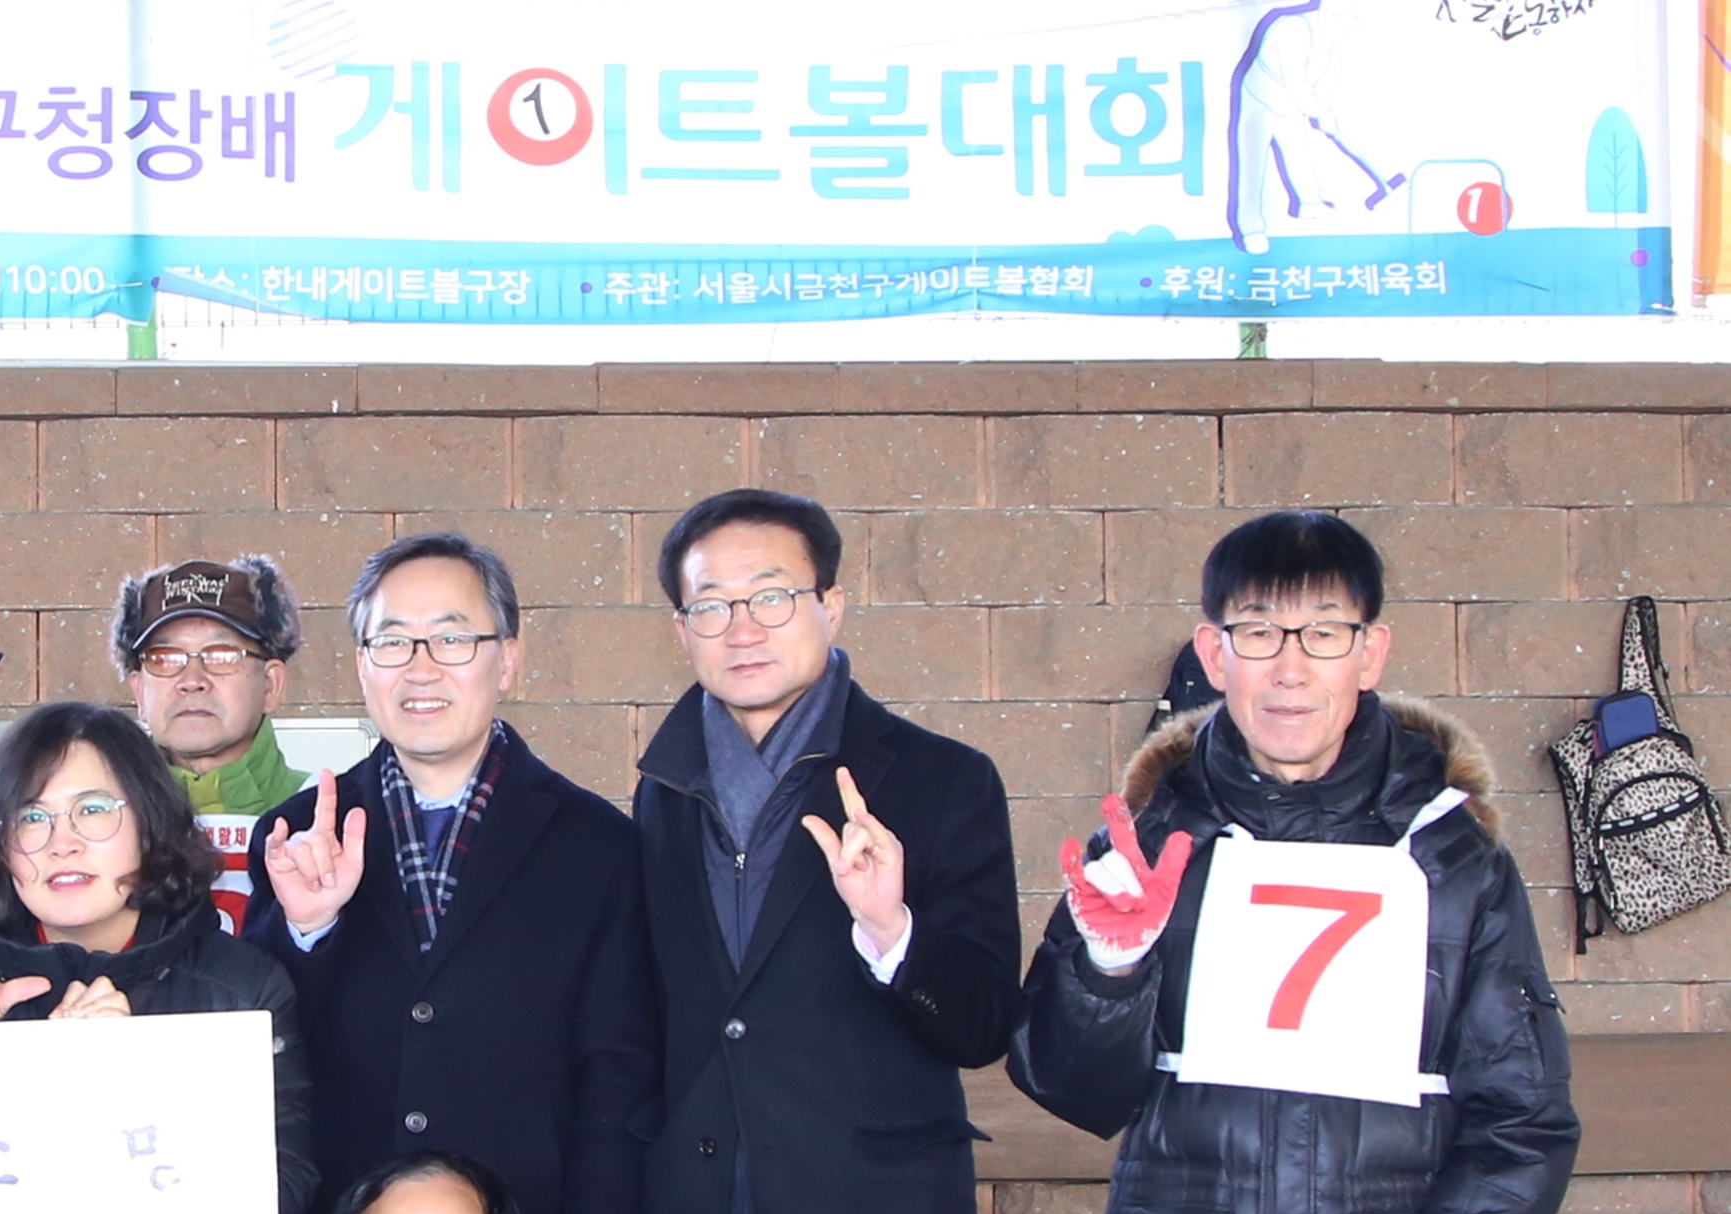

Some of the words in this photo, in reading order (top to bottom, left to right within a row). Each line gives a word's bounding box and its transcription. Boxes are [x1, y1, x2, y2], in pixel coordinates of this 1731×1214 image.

[334, 57, 1206, 200] 게이트볼대회
[262, 266, 531, 305] 한내게이트볼구장
[603, 272, 681, 305] 주관:
[693, 264, 1095, 305] 서울시금천구게이트볼협회
[1159, 265, 1237, 301] 후원:
[1247, 261, 1448, 304] 금천구체육회
[1250, 884, 1383, 1030] 7
